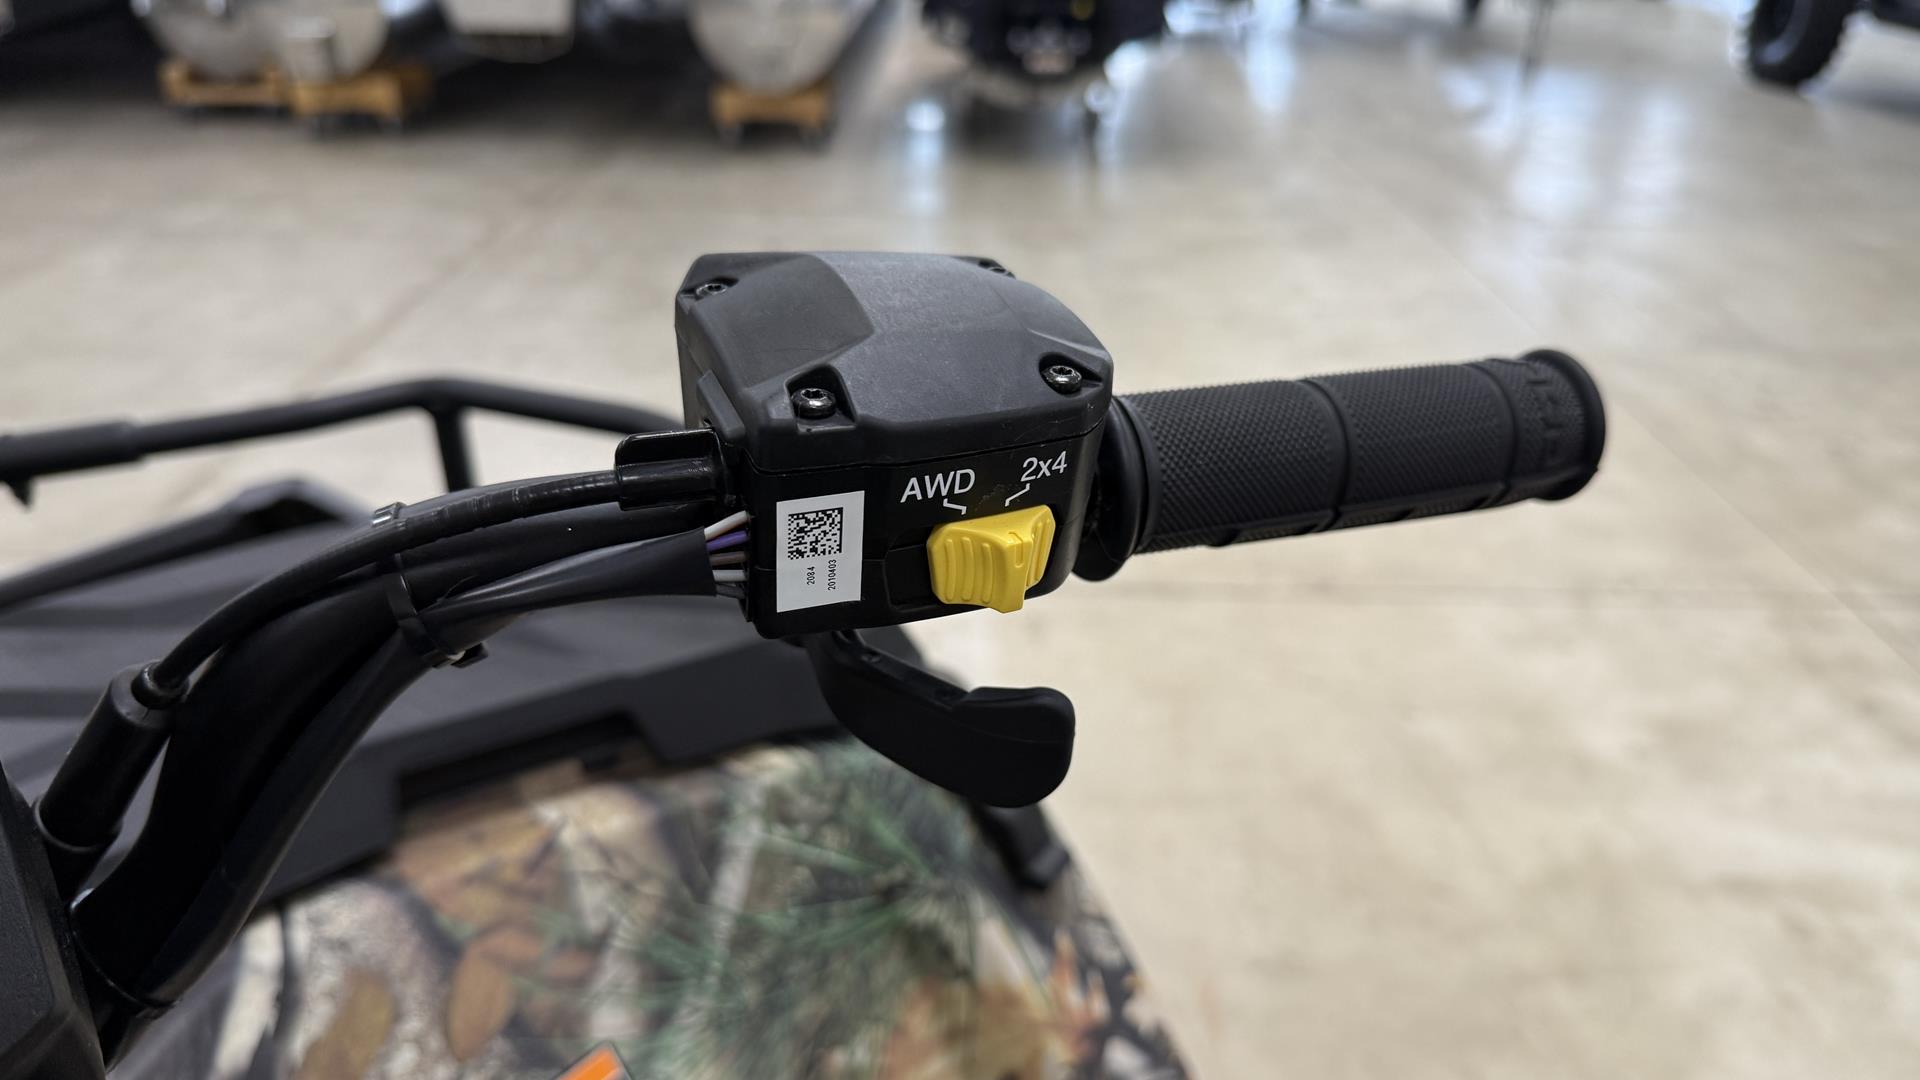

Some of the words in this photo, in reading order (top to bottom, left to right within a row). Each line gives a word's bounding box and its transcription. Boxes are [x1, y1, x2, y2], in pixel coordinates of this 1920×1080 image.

[1020, 450, 1068, 482] 2x4
[900, 468, 976, 503] AWD
[806, 566, 816, 585] 2084
[827, 559, 837, 591] 2010403
